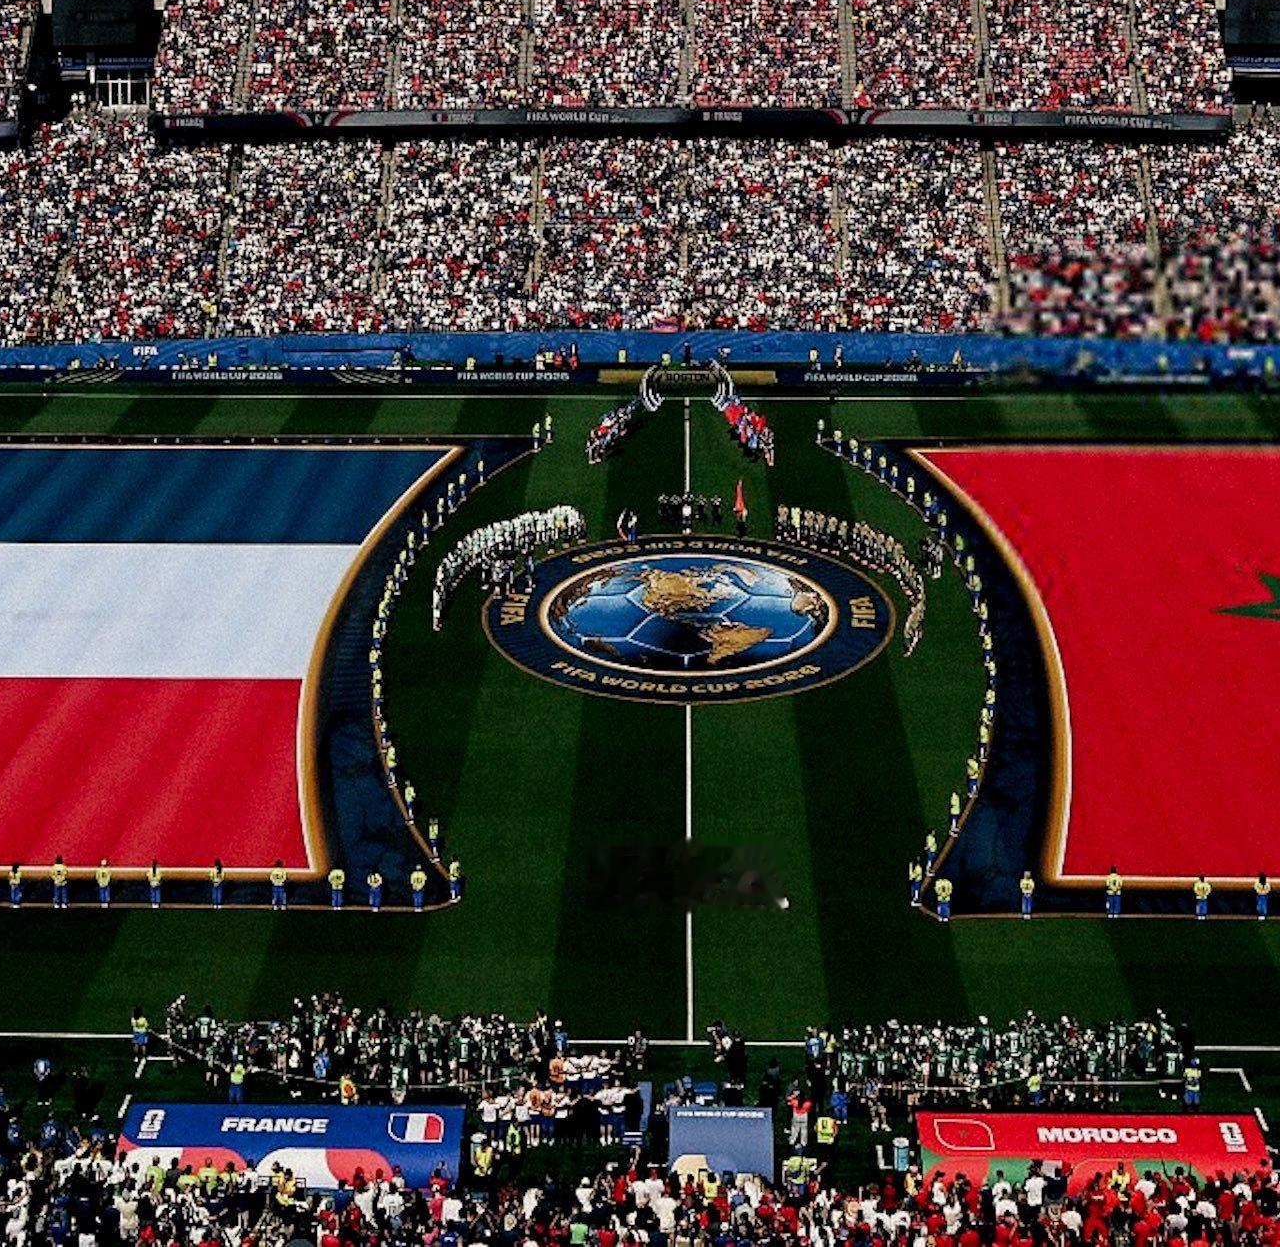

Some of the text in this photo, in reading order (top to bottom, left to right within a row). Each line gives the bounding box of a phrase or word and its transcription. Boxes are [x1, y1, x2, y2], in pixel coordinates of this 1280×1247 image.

[133, 346, 159, 356] FIFA
[849, 596, 875, 629] FIFA
[601, 675, 688, 694] WORLD
[691, 682, 741, 694] CUP
[220, 1117, 330, 1134] FRANCE
[1037, 1127, 1178, 1144] MOROCCO
